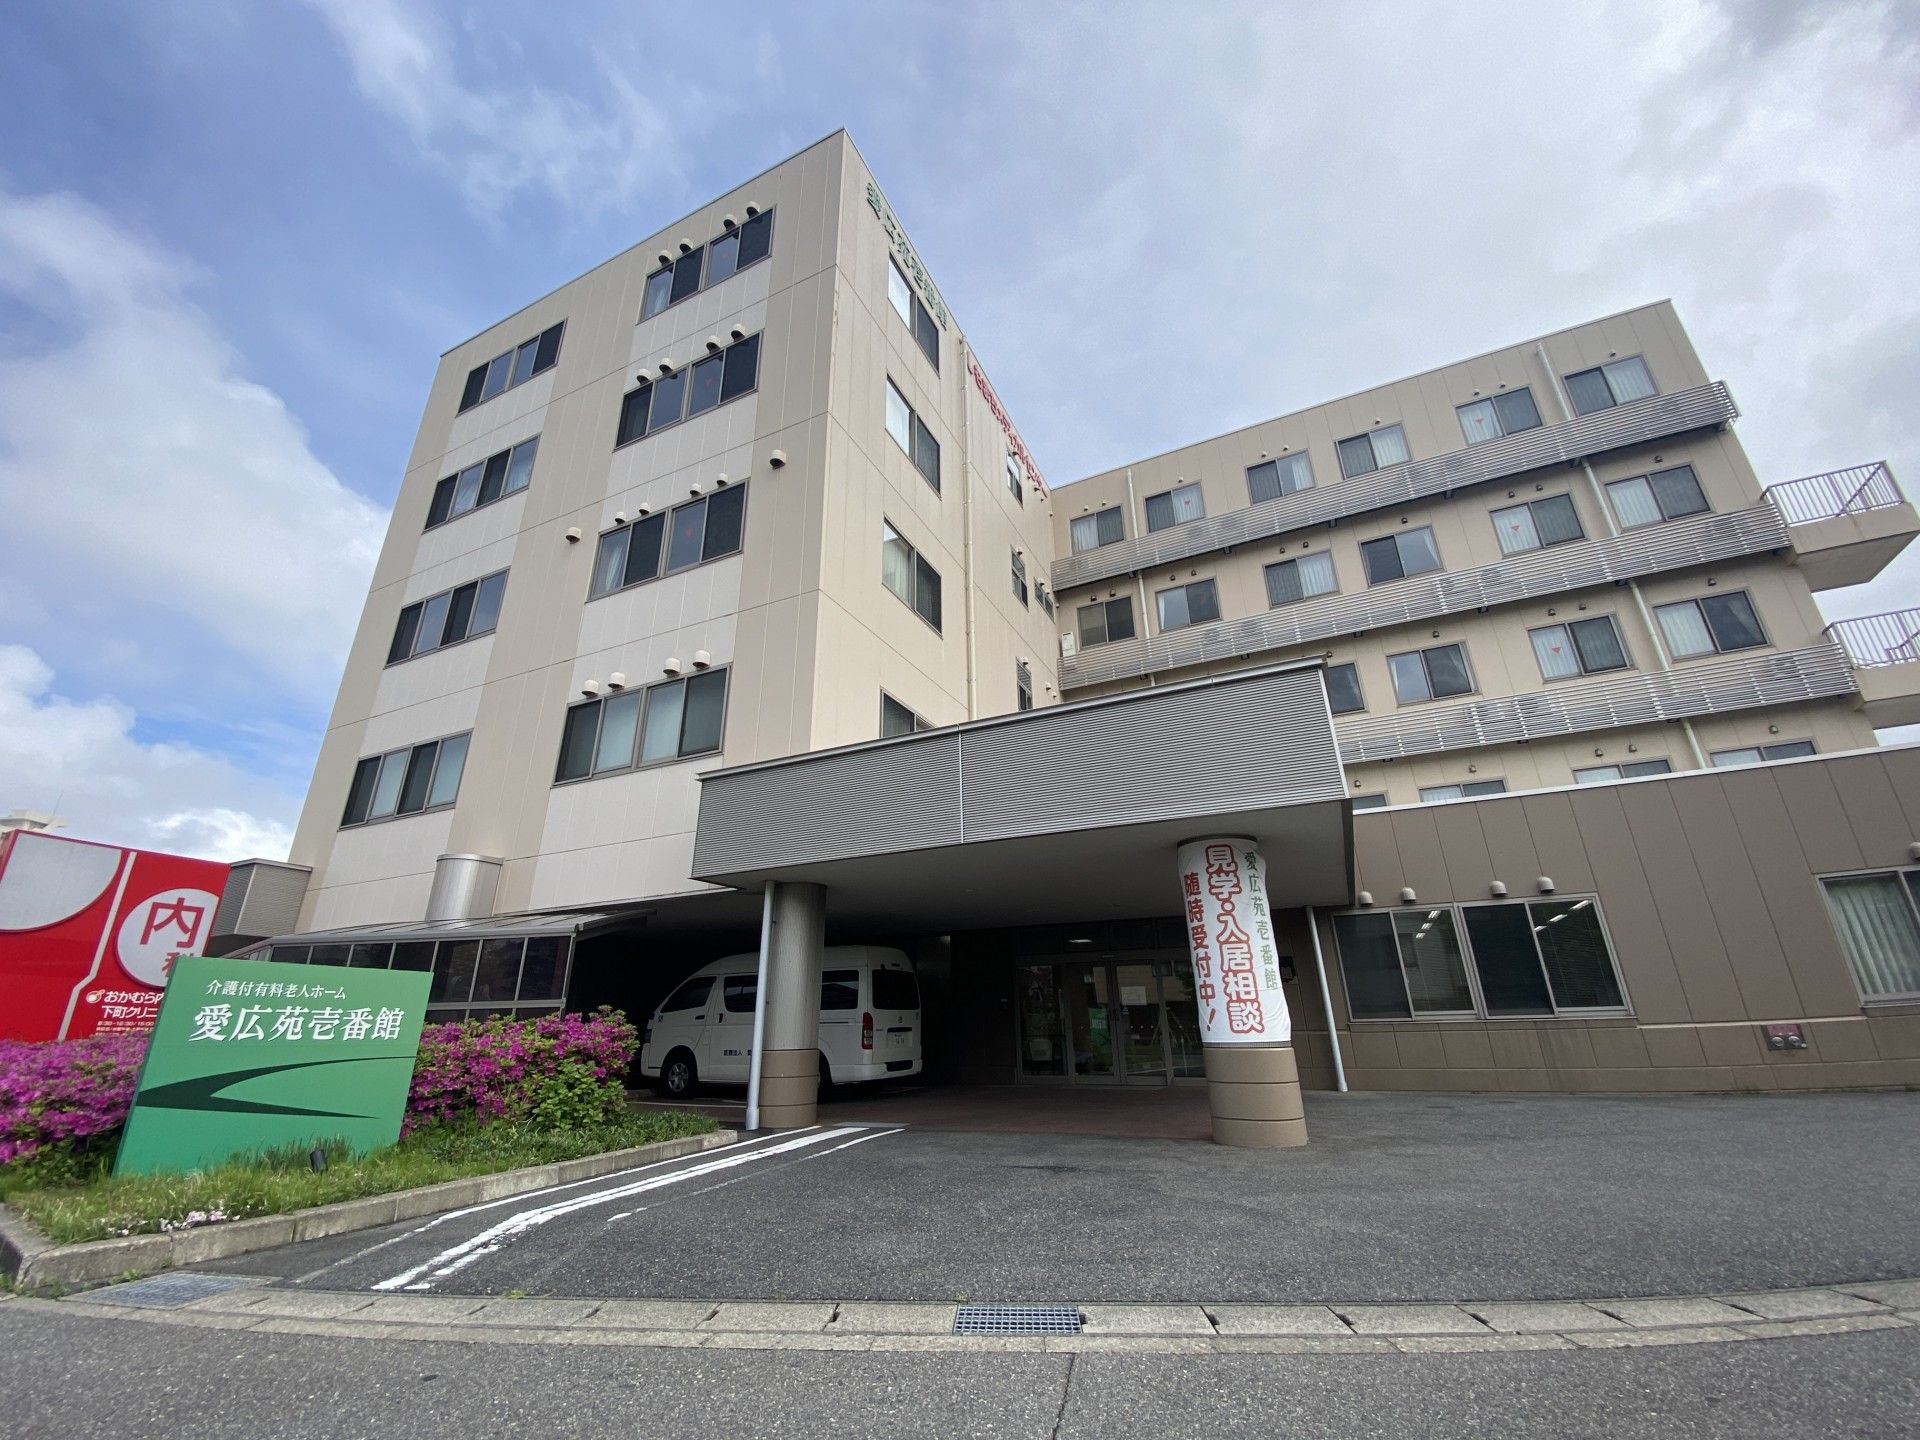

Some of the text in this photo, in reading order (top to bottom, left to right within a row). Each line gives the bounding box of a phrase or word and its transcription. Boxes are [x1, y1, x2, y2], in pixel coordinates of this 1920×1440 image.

[1244, 851, 1278, 990] 愛広苑壱番館
[205, 979, 347, 1000] 介護付有料老人ホーム
[188, 1003, 405, 1042] 愛広苑壱番館
